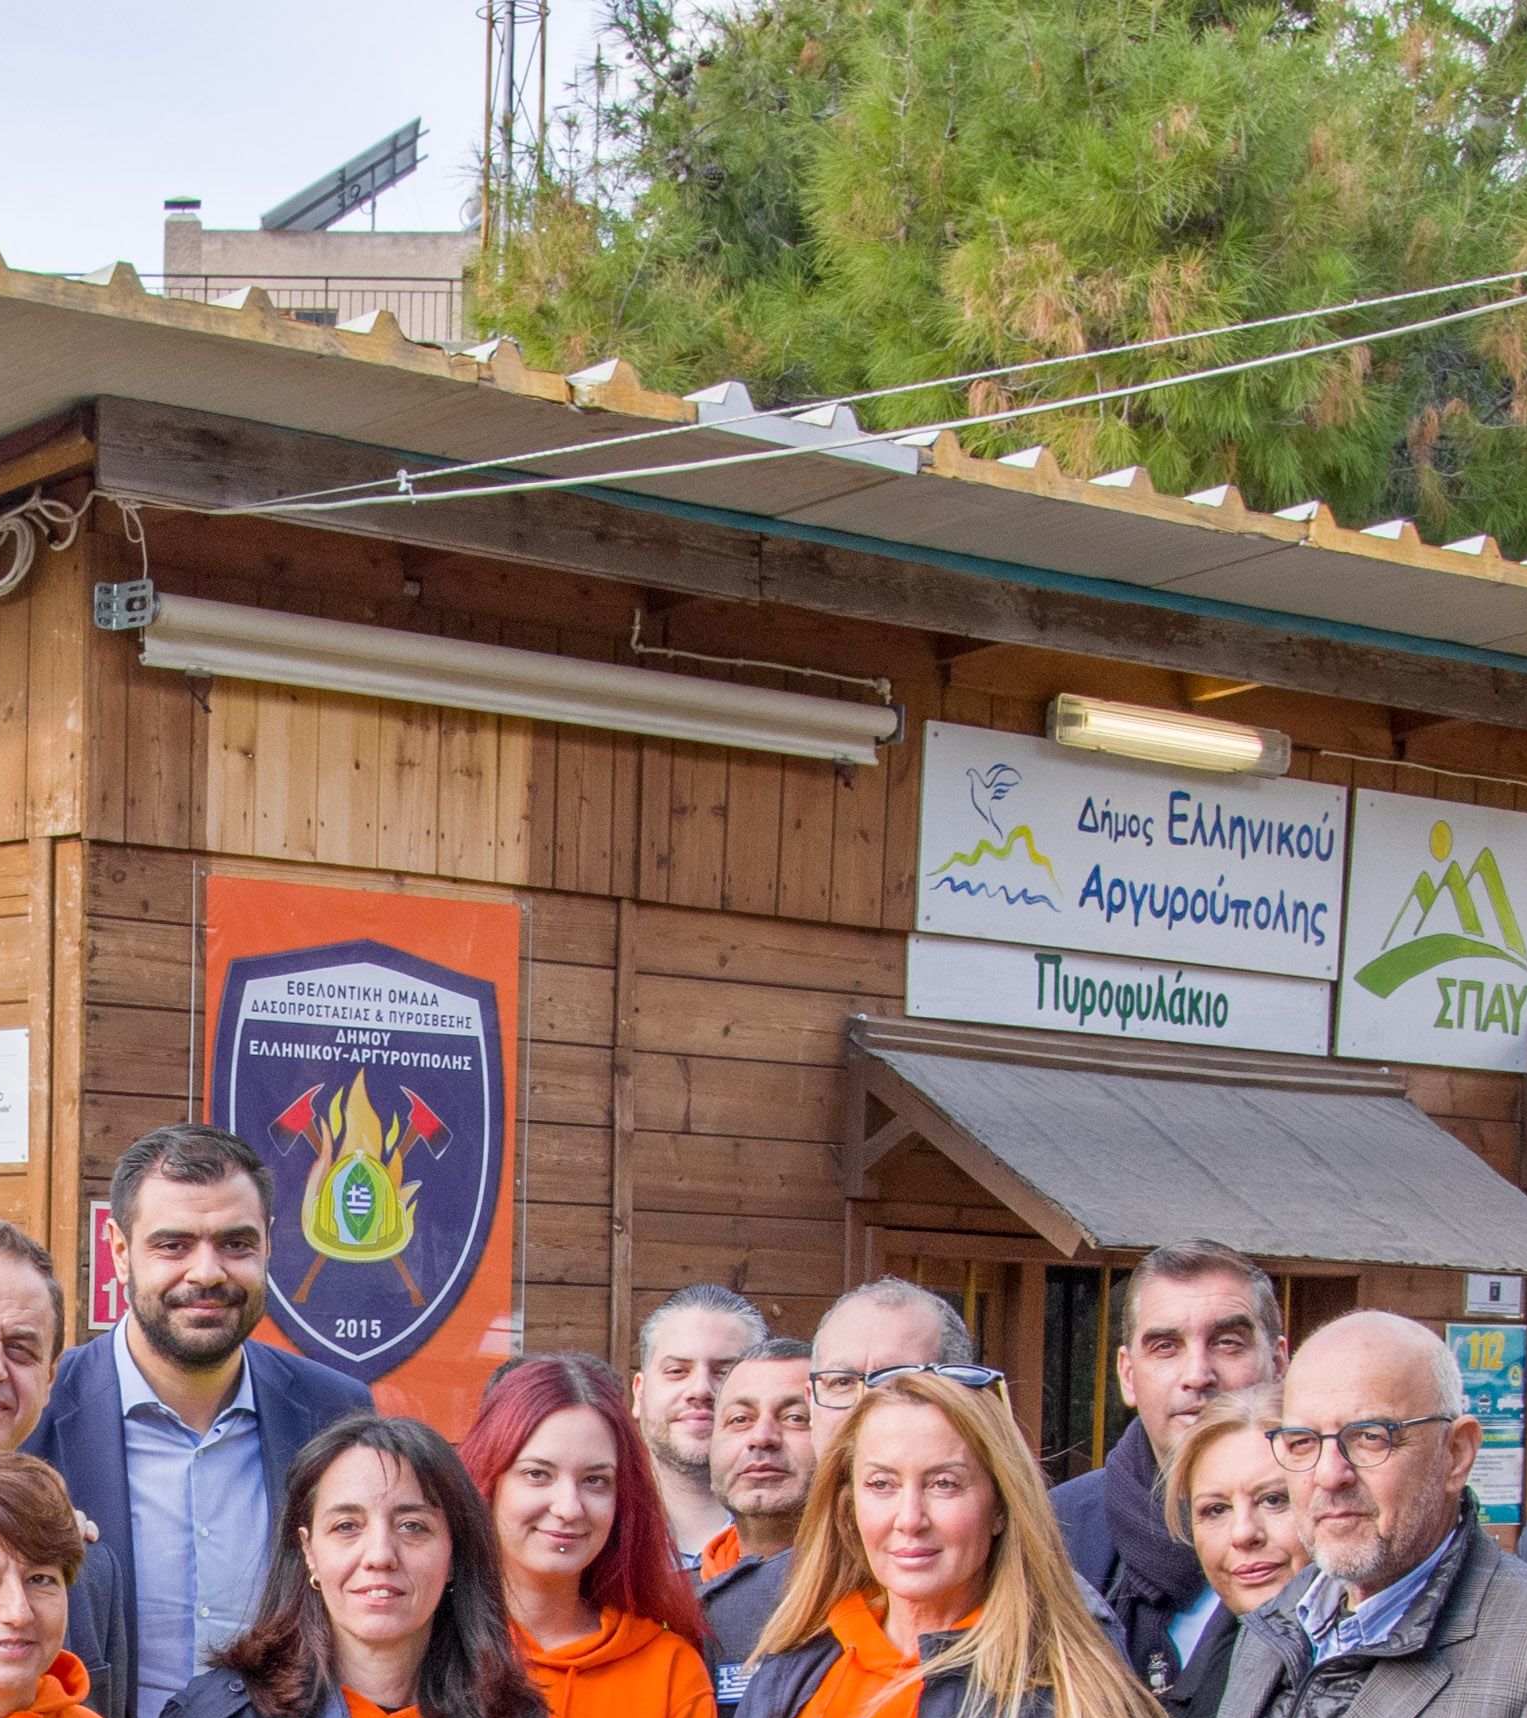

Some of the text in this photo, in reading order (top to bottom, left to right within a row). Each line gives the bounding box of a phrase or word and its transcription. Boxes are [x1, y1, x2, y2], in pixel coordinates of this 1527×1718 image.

[1077, 791, 1334, 861] Δήμος Ελληνικού
[1078, 864, 1329, 946] Αργυρούπολης
[286, 980, 440, 1008] ΕΘΕΛΟΝΤΙΚΗ ΟΜΑΔΑ
[1034, 952, 1229, 1032] Πυροφυλάκιο
[250, 999, 473, 1030] ΔΑΣΟΠΡΟΣΤΑΣΙΑΣ & ΠΥΡΟΣΒΕΣΗΣ
[335, 1029, 392, 1047] ΔΗΜΟΥ
[249, 1040, 473, 1071] ΕΛΛΗΝΙΚΟΥ-ΑΡΓΥΡΟΥΠΟΛΗΣ
[335, 1318, 382, 1339] 2015
[1467, 1331, 1506, 1371] 112
